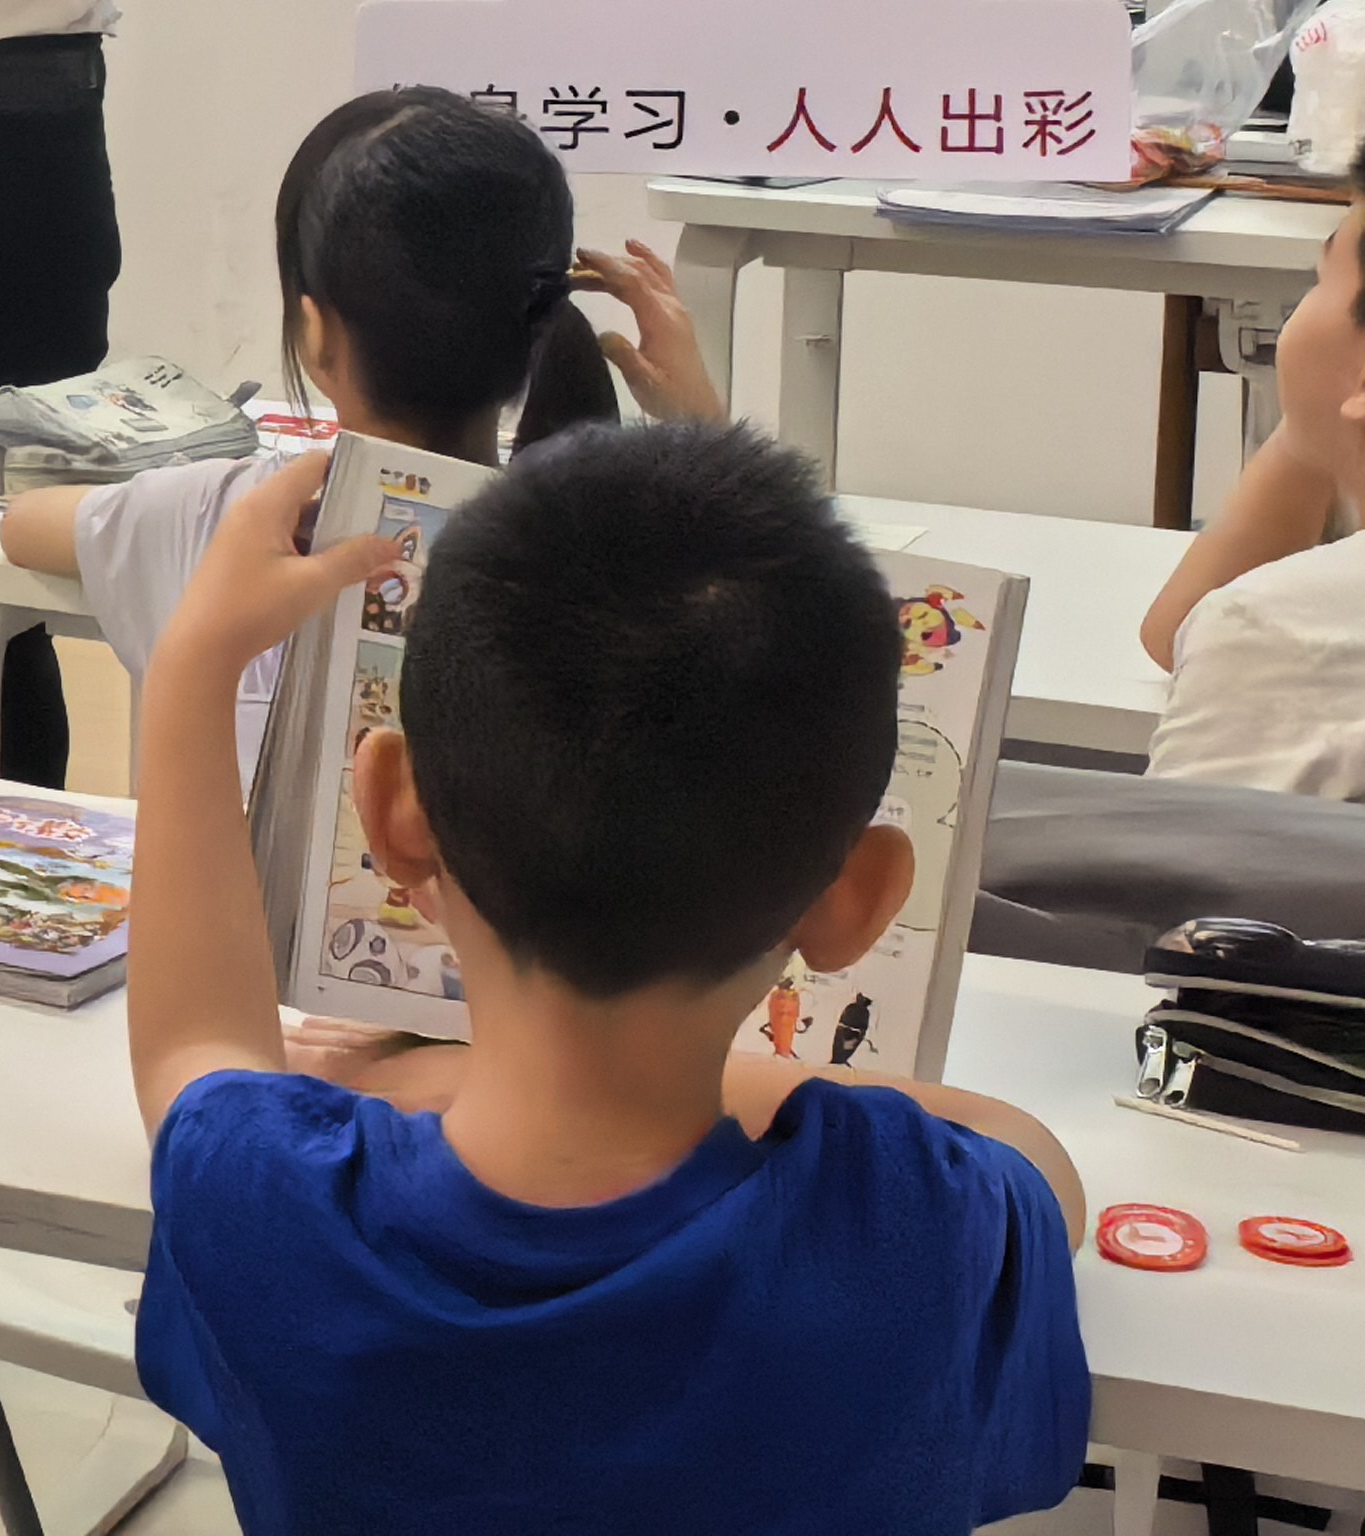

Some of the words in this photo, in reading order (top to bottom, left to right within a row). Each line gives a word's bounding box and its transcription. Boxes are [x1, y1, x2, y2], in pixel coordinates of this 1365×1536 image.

[469, 83, 1098, 158] 学习·人人出彩
